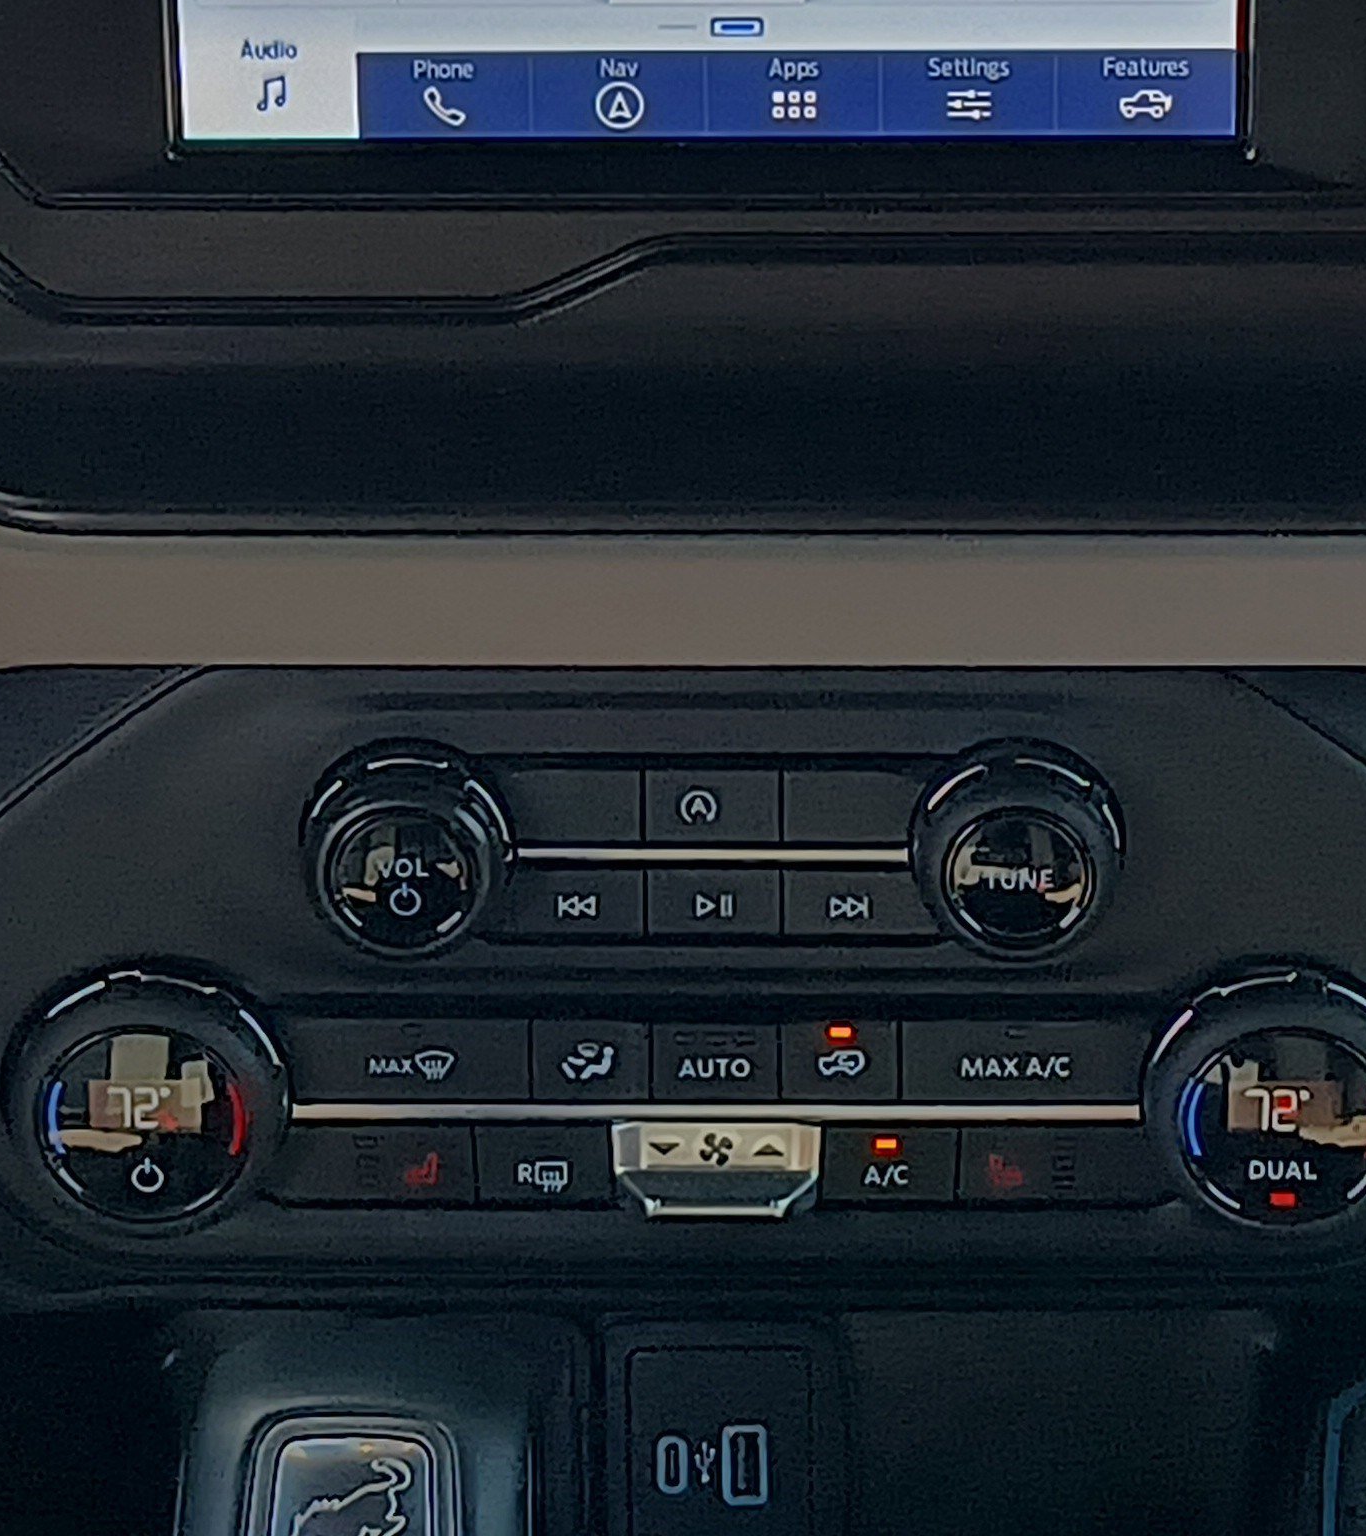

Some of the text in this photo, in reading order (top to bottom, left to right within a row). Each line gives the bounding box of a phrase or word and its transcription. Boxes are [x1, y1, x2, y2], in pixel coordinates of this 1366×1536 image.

[239, 38, 298, 60] Audio
[412, 59, 475, 80] Phone
[600, 59, 638, 78] Nav
[768, 58, 820, 80] Apps
[927, 58, 1011, 81] Settings
[1102, 57, 1190, 78] Features
[378, 858, 431, 879] VOL
[980, 868, 1056, 892] TUNE
[368, 1058, 414, 1076] MAX
[678, 1056, 751, 1079] AUTO
[960, 1056, 1070, 1079] MAX A/C
[863, 1164, 910, 1187] A/C
[1247, 1159, 1318, 1181] DUAL
